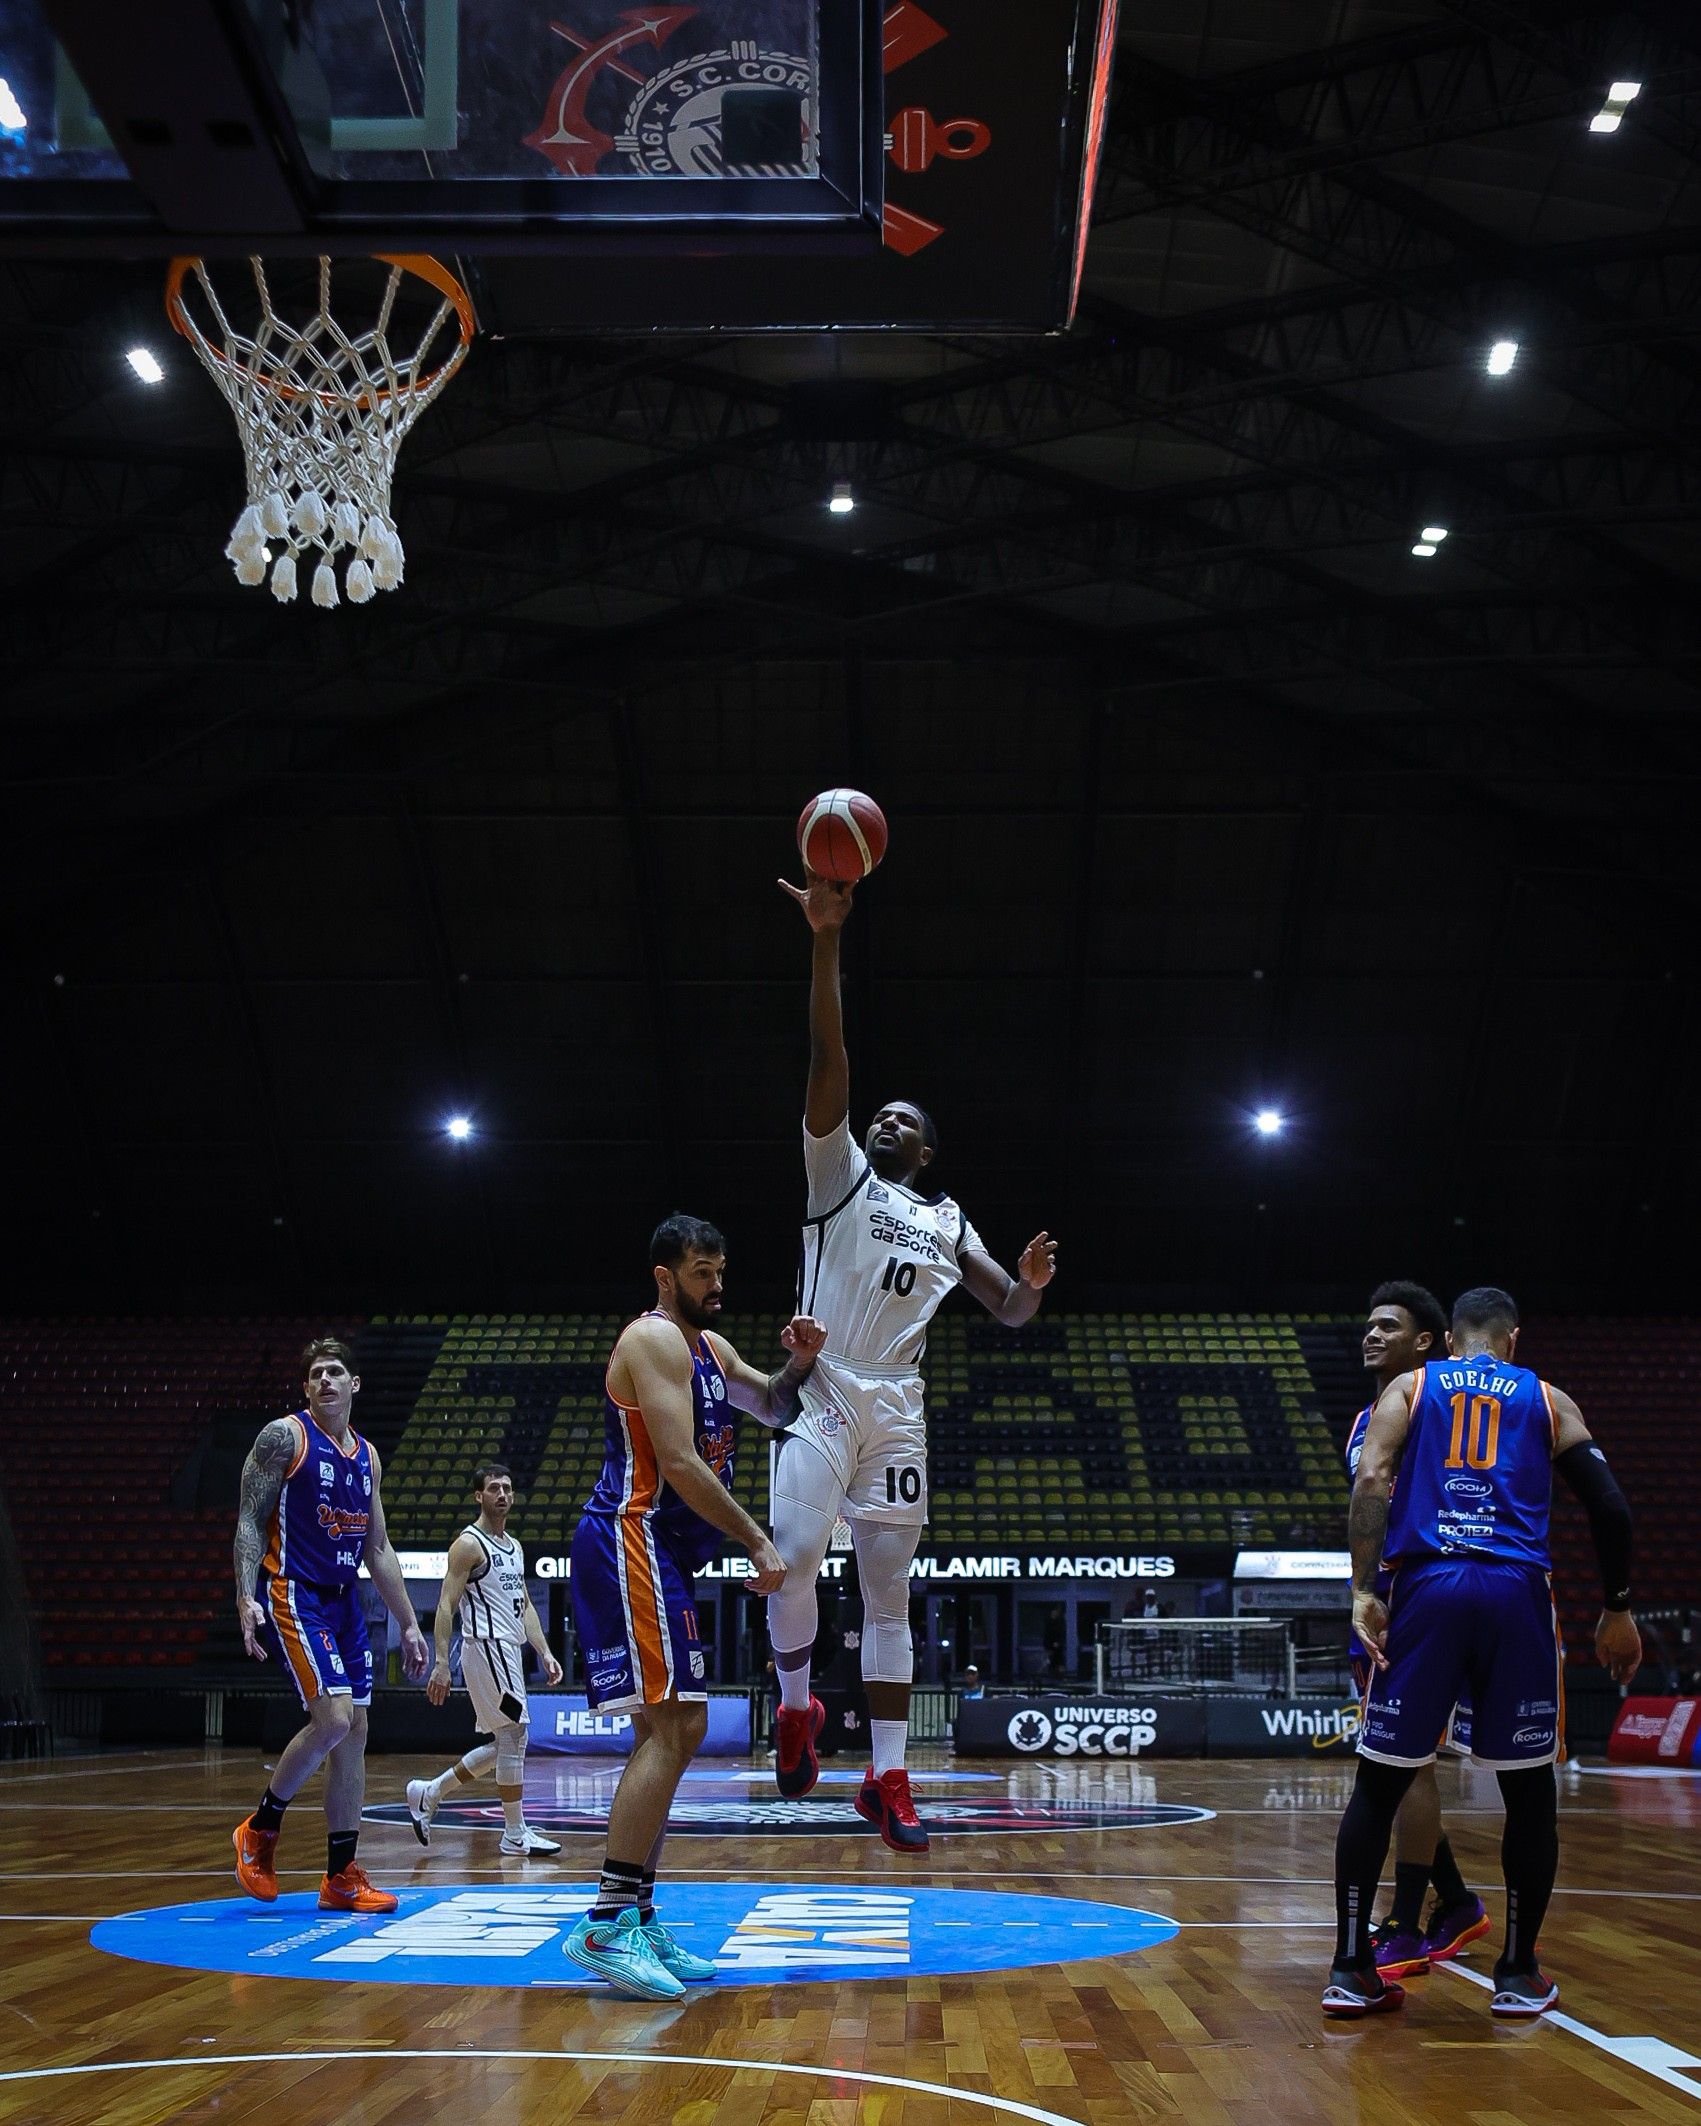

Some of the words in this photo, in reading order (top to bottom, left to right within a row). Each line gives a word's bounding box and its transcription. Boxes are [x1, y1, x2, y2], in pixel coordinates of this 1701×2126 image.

[738, 62, 810, 93] COR
[869, 1210, 943, 1252] Esportes
[881, 1256, 917, 1298] 10
[1439, 1371, 1518, 1397] COELHO
[1444, 1392, 1501, 1470] 10
[886, 1466, 921, 1504] 10
[1438, 1509, 1495, 1522] Redepharma
[908, 1557, 1021, 1578] WLAMIR
[1029, 1556, 1175, 1579] MARQUES
[556, 1711, 632, 1736] HELP
[1054, 1706, 1158, 1724] UNIVERSO
[1261, 1708, 1360, 1743] Whirlp
[1053, 1724, 1157, 1756] SCCP
[714, 1893, 915, 1967] CAIXA
